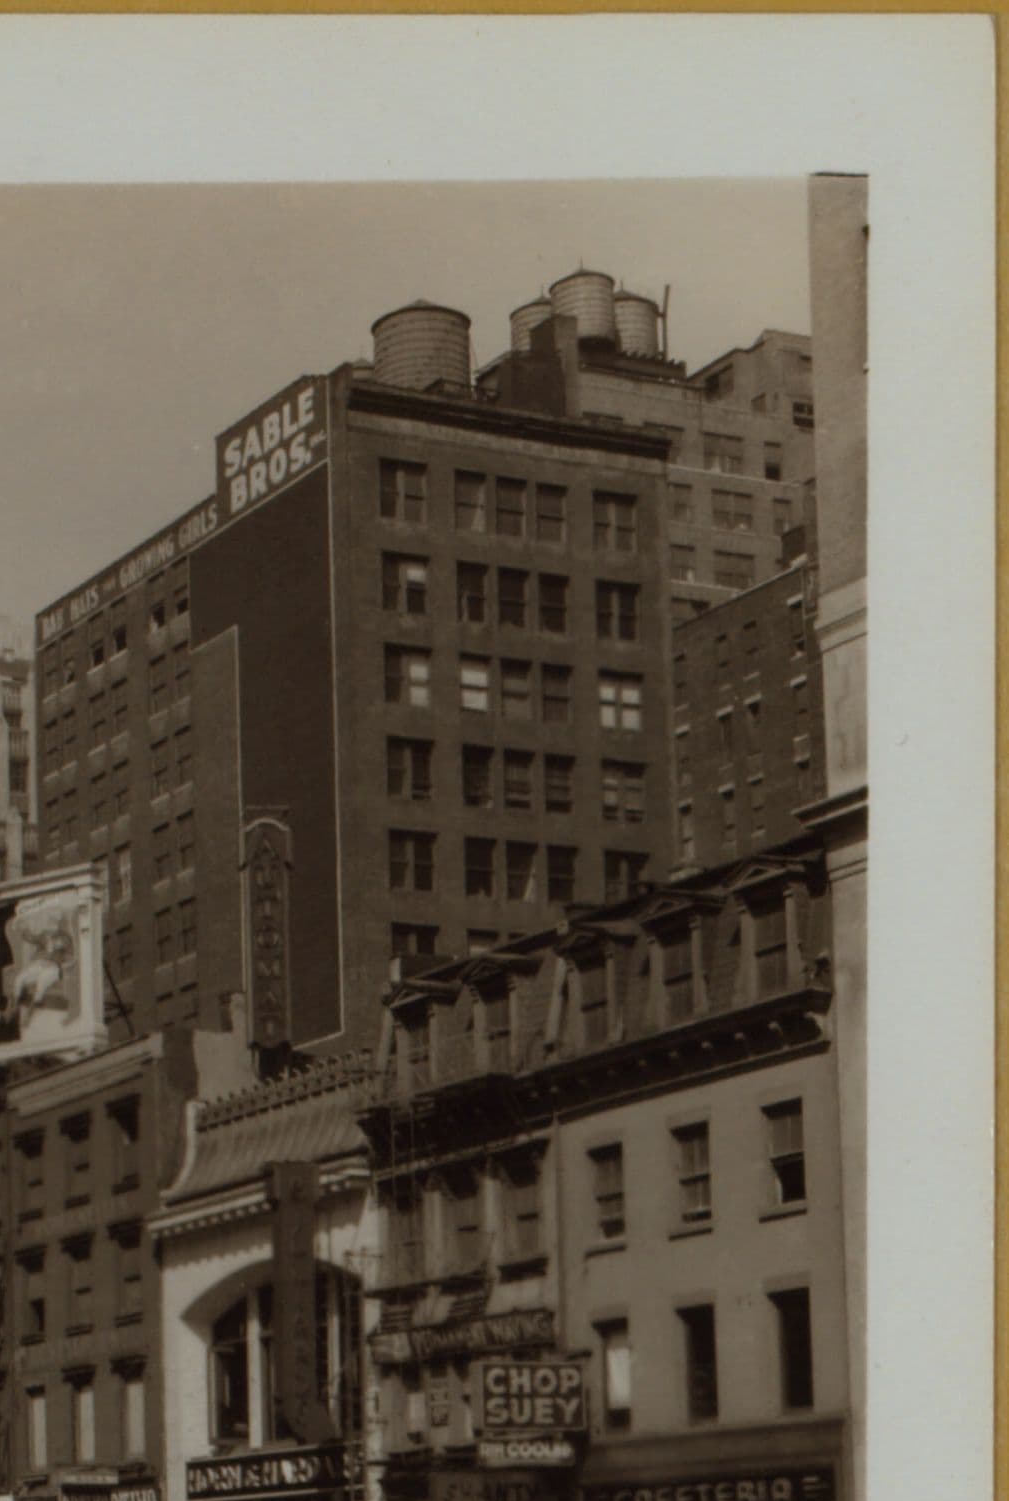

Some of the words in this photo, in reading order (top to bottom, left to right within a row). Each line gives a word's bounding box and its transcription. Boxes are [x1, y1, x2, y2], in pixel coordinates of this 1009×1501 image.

[224, 387, 315, 479] SABLE
[229, 432, 311, 515] BROS.
[178, 503, 218, 549] GIRLS
[485, 1366, 581, 1395] CHOP
[486, 1397, 581, 1426] SUEY
